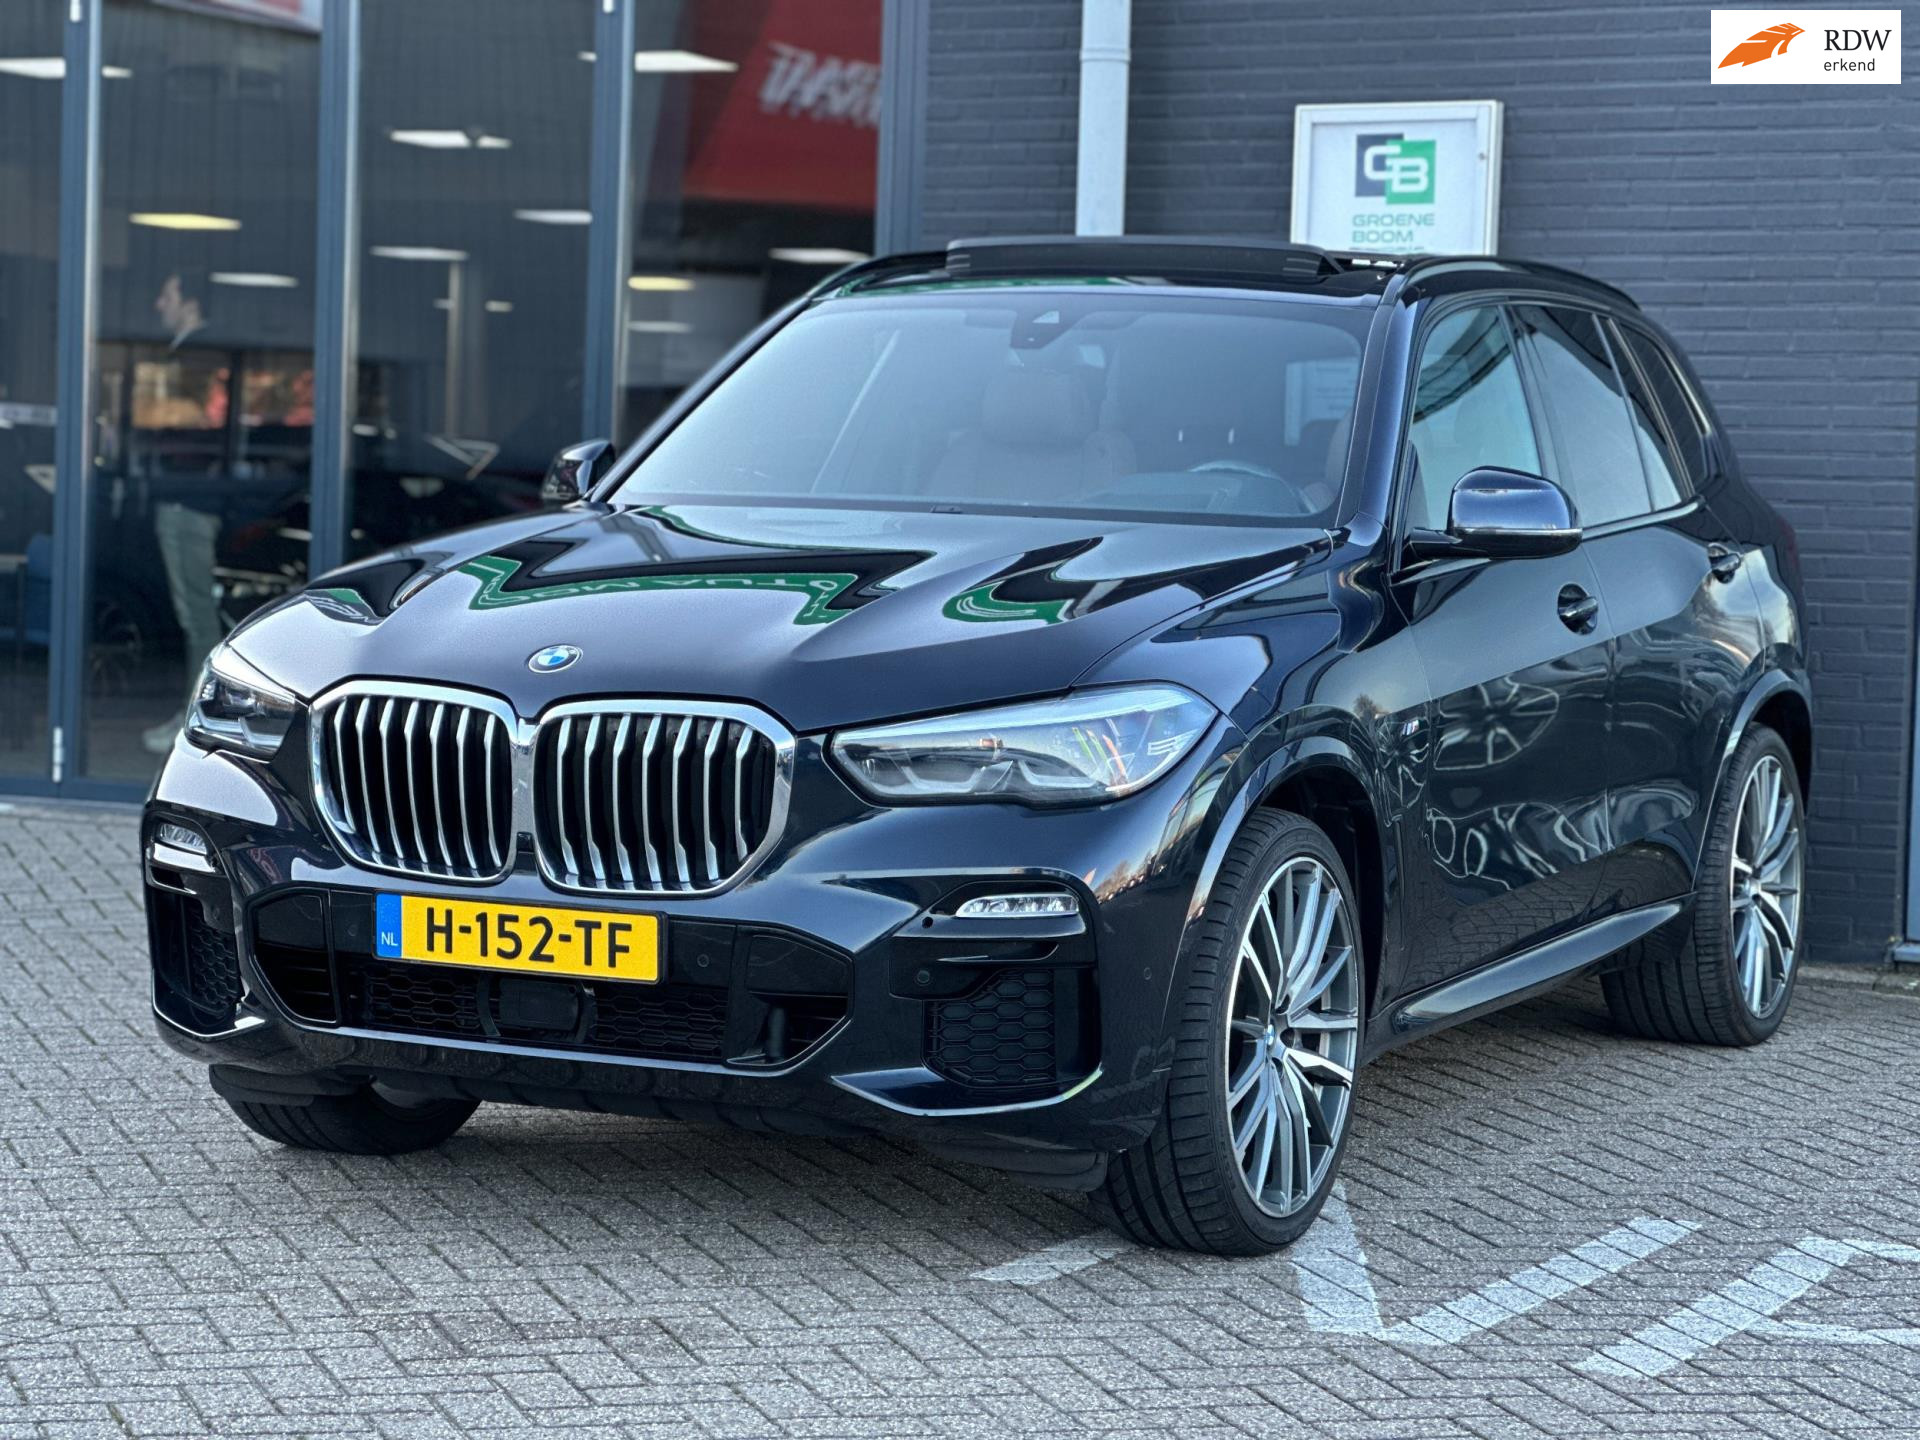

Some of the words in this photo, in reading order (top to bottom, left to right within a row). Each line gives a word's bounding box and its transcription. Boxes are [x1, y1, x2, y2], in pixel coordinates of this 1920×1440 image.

[1352, 212, 1436, 228] GROENE
[1352, 229, 1414, 243] BOOM
[380, 931, 399, 947] NL
[425, 906, 632, 968] H-152-TF
